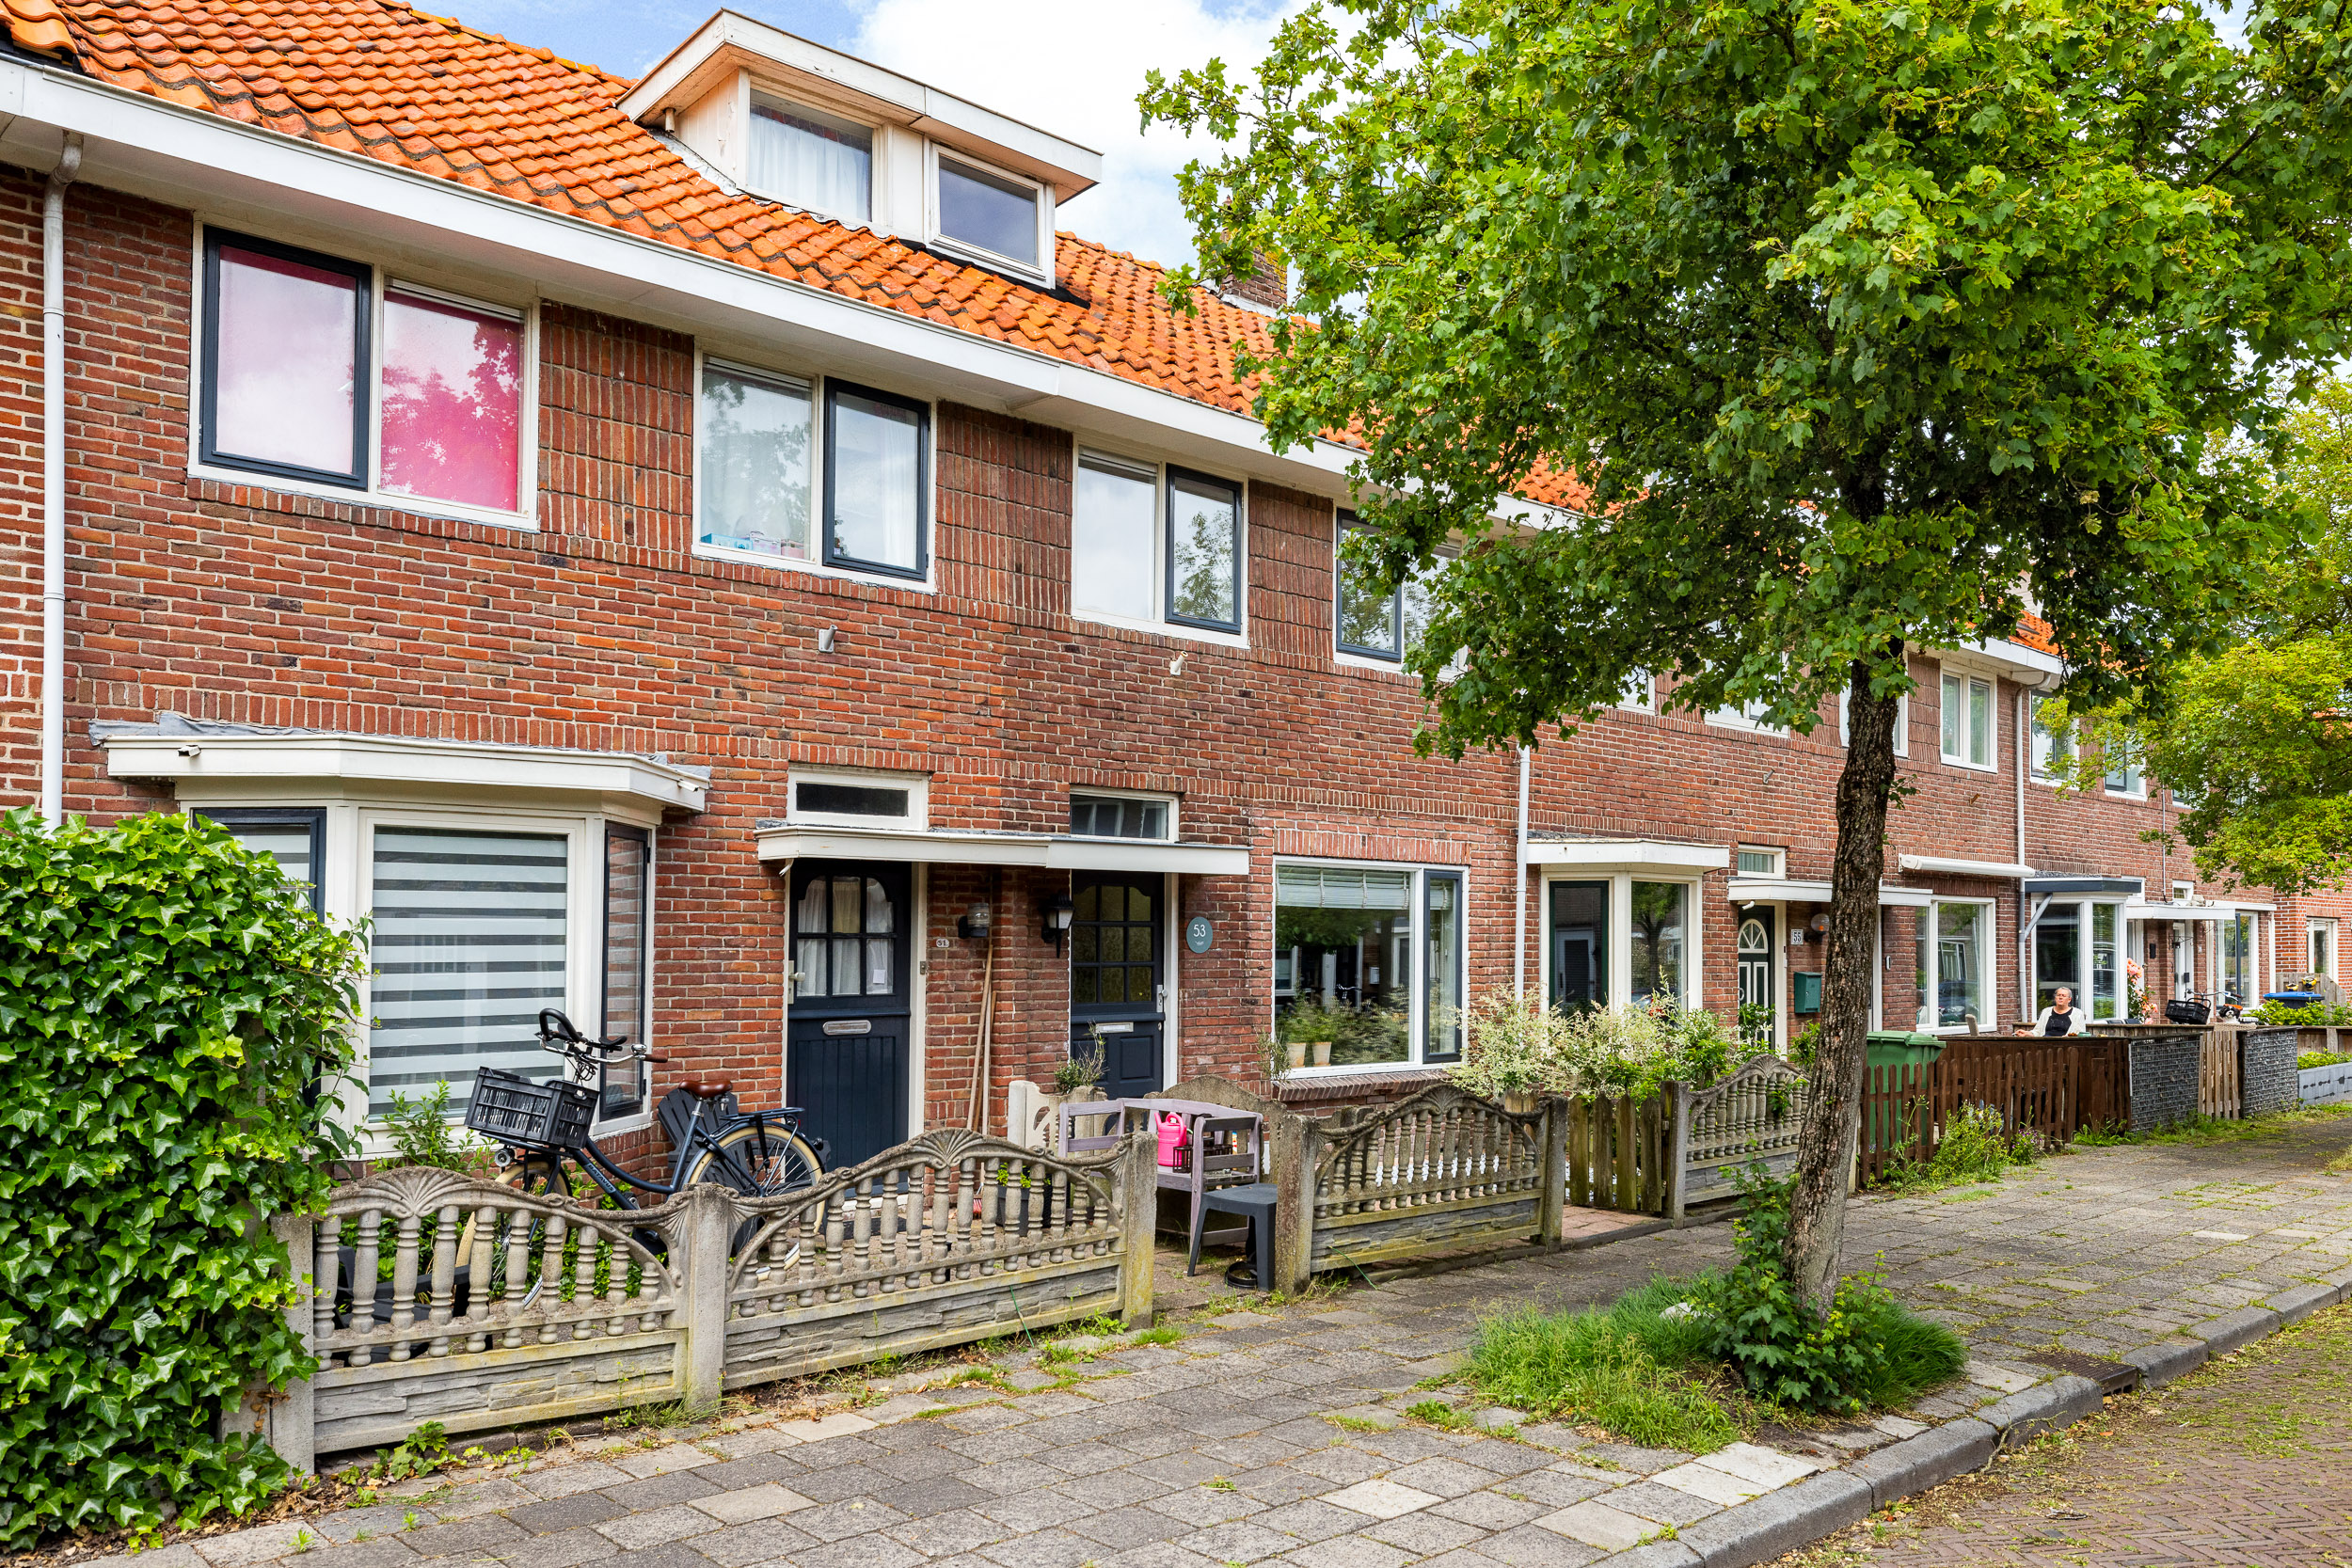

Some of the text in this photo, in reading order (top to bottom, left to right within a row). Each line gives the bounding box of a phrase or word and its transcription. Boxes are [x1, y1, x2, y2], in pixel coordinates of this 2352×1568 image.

[1193, 924, 1206, 938] 53
[1793, 931, 1802, 942] 55
[588, 1164, 614, 1191] BATAVUS
